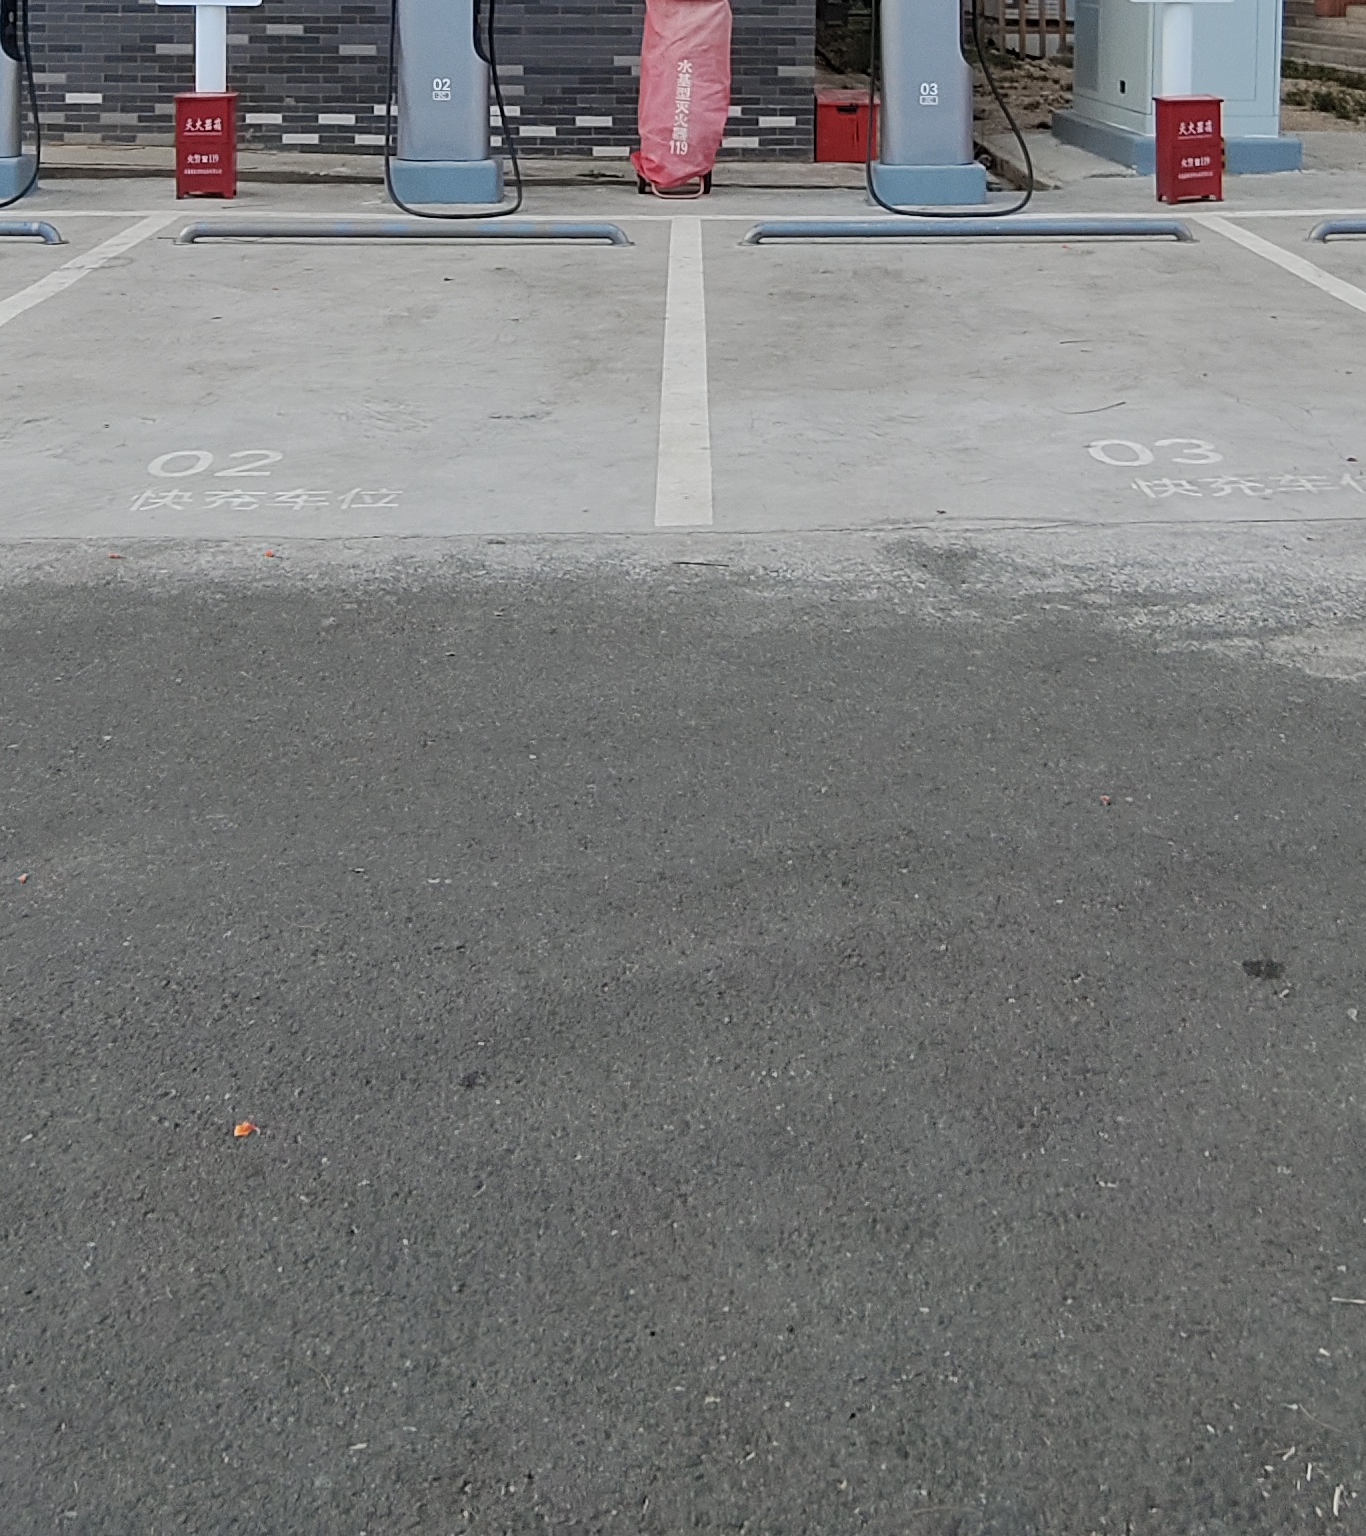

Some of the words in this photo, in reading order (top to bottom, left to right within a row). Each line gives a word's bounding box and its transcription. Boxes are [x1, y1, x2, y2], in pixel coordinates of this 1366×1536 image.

[433, 78, 451, 91] 02
[920, 82, 938, 95] 03
[669, 140, 688, 155] 119
[1088, 438, 1223, 466] 03
[147, 450, 283, 477] 02
[129, 487, 403, 511] 快充车位
